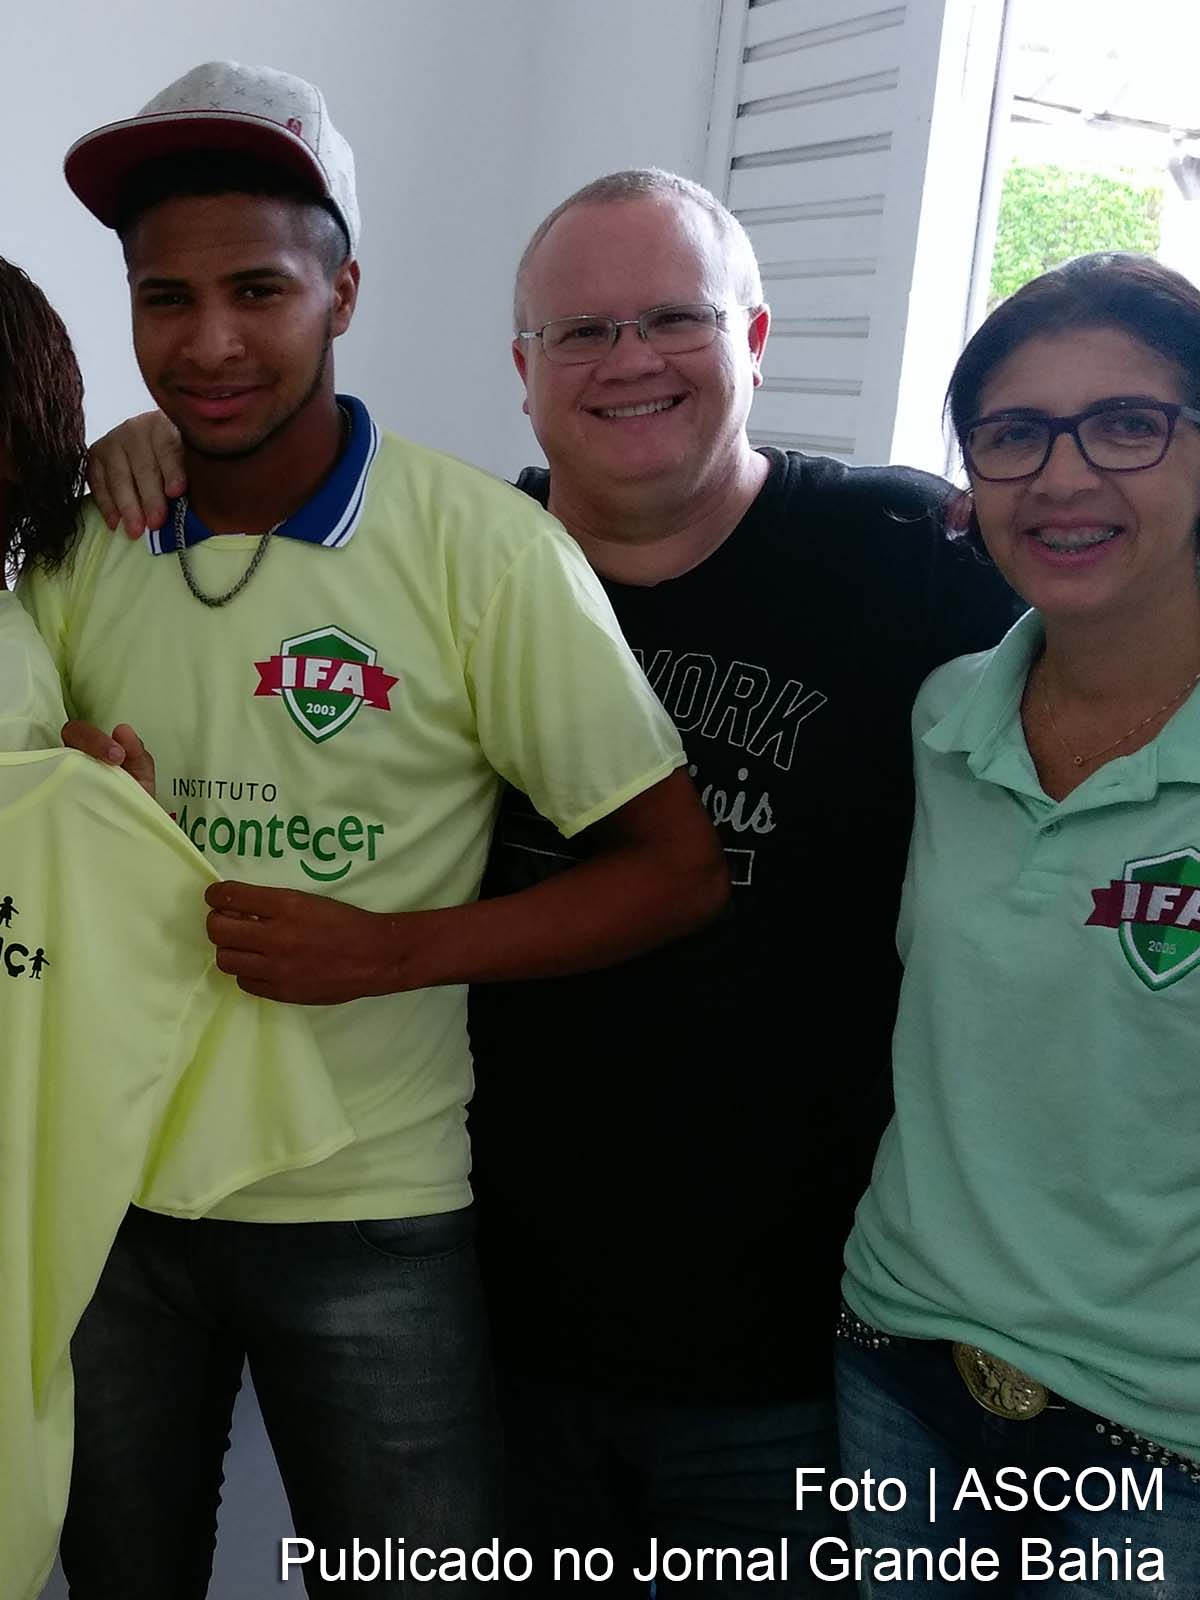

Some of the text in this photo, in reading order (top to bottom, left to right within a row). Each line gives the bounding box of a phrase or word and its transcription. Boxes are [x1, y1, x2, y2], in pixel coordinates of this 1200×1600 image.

[281, 657, 365, 697] IFA
[306, 703, 336, 717] 2003
[172, 777, 278, 802] INSTITUTO
[170, 804, 385, 861] Acontecer
[1121, 882, 1200, 926] IFA
